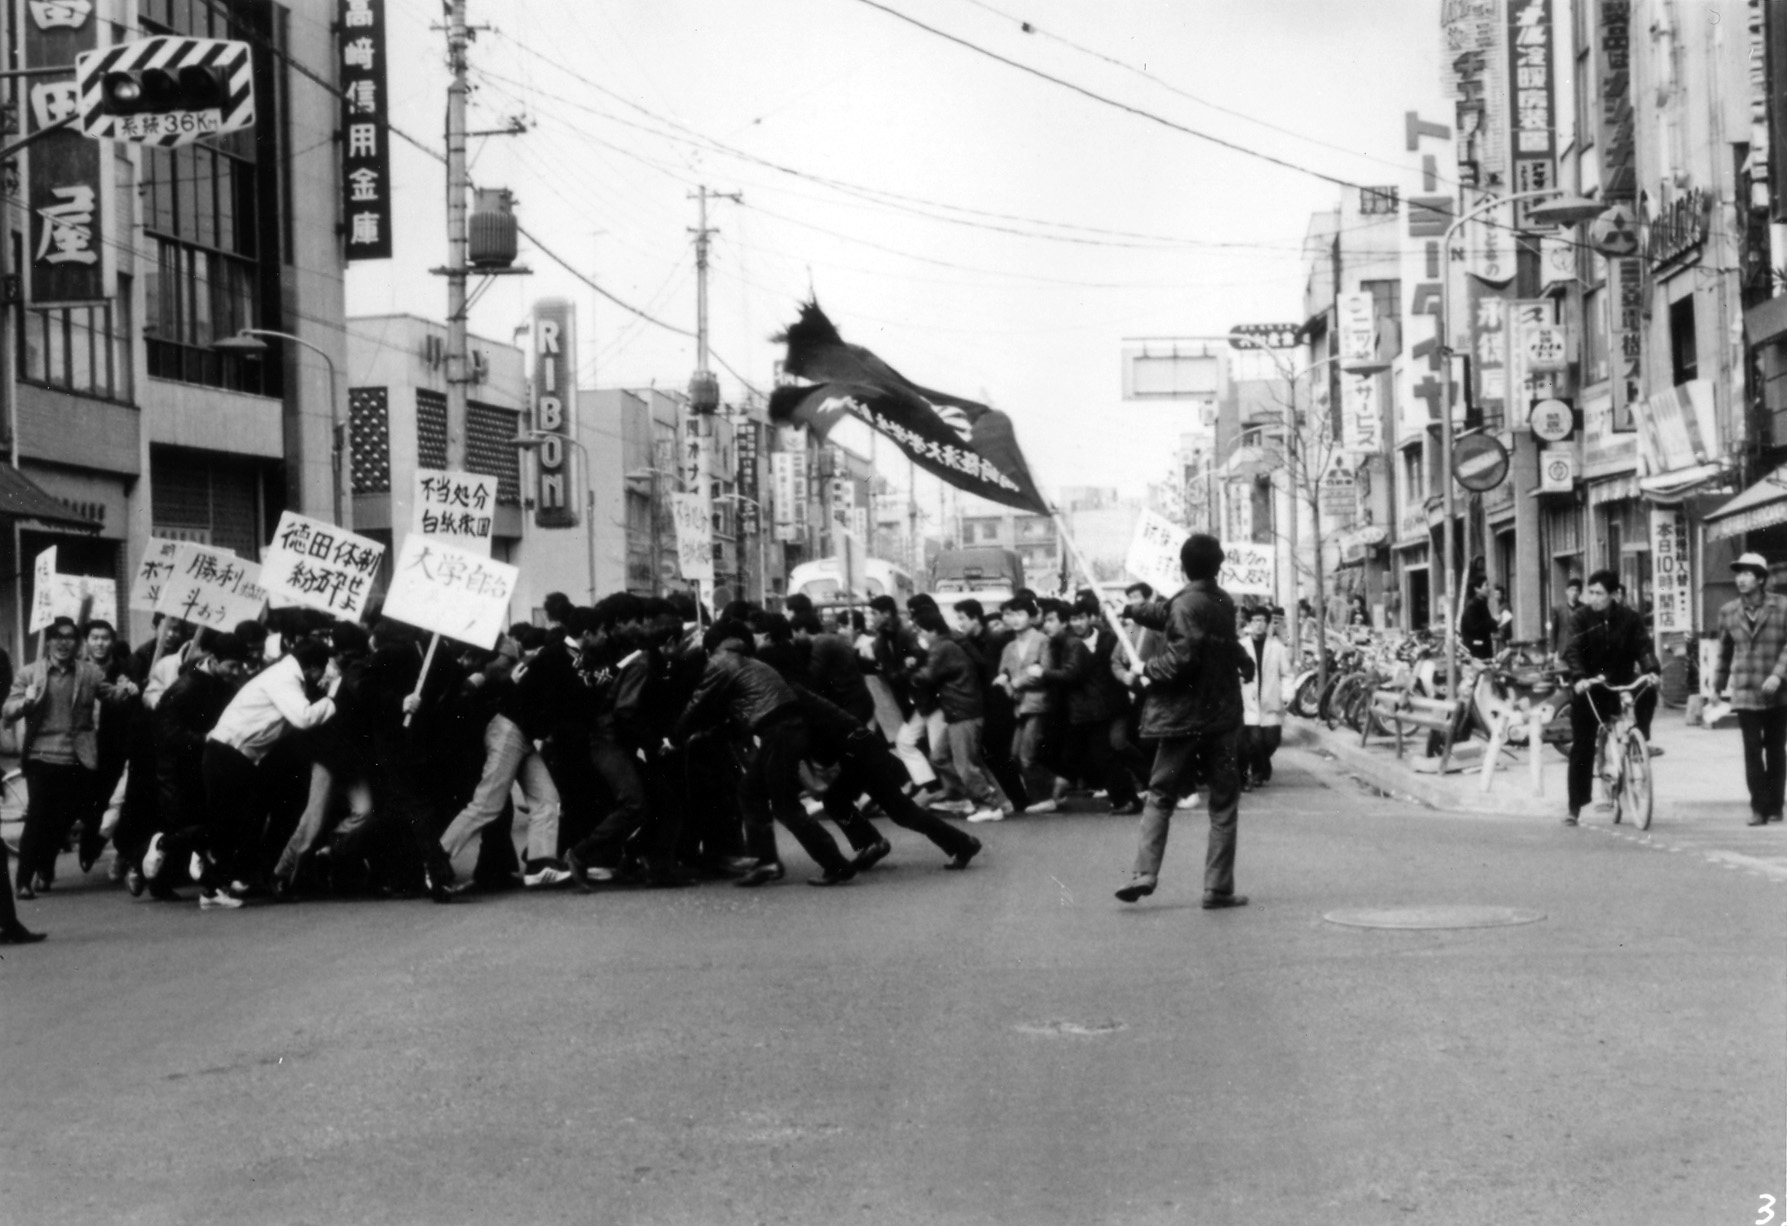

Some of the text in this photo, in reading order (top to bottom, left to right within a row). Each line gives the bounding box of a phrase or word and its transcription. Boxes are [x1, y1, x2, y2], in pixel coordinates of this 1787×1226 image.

[345, 0, 380, 244] 高崎信用金庫
[538, 319, 565, 508] RIBON
[420, 475, 490, 510] 不当処分
[404, 545, 507, 600] 大学自治
